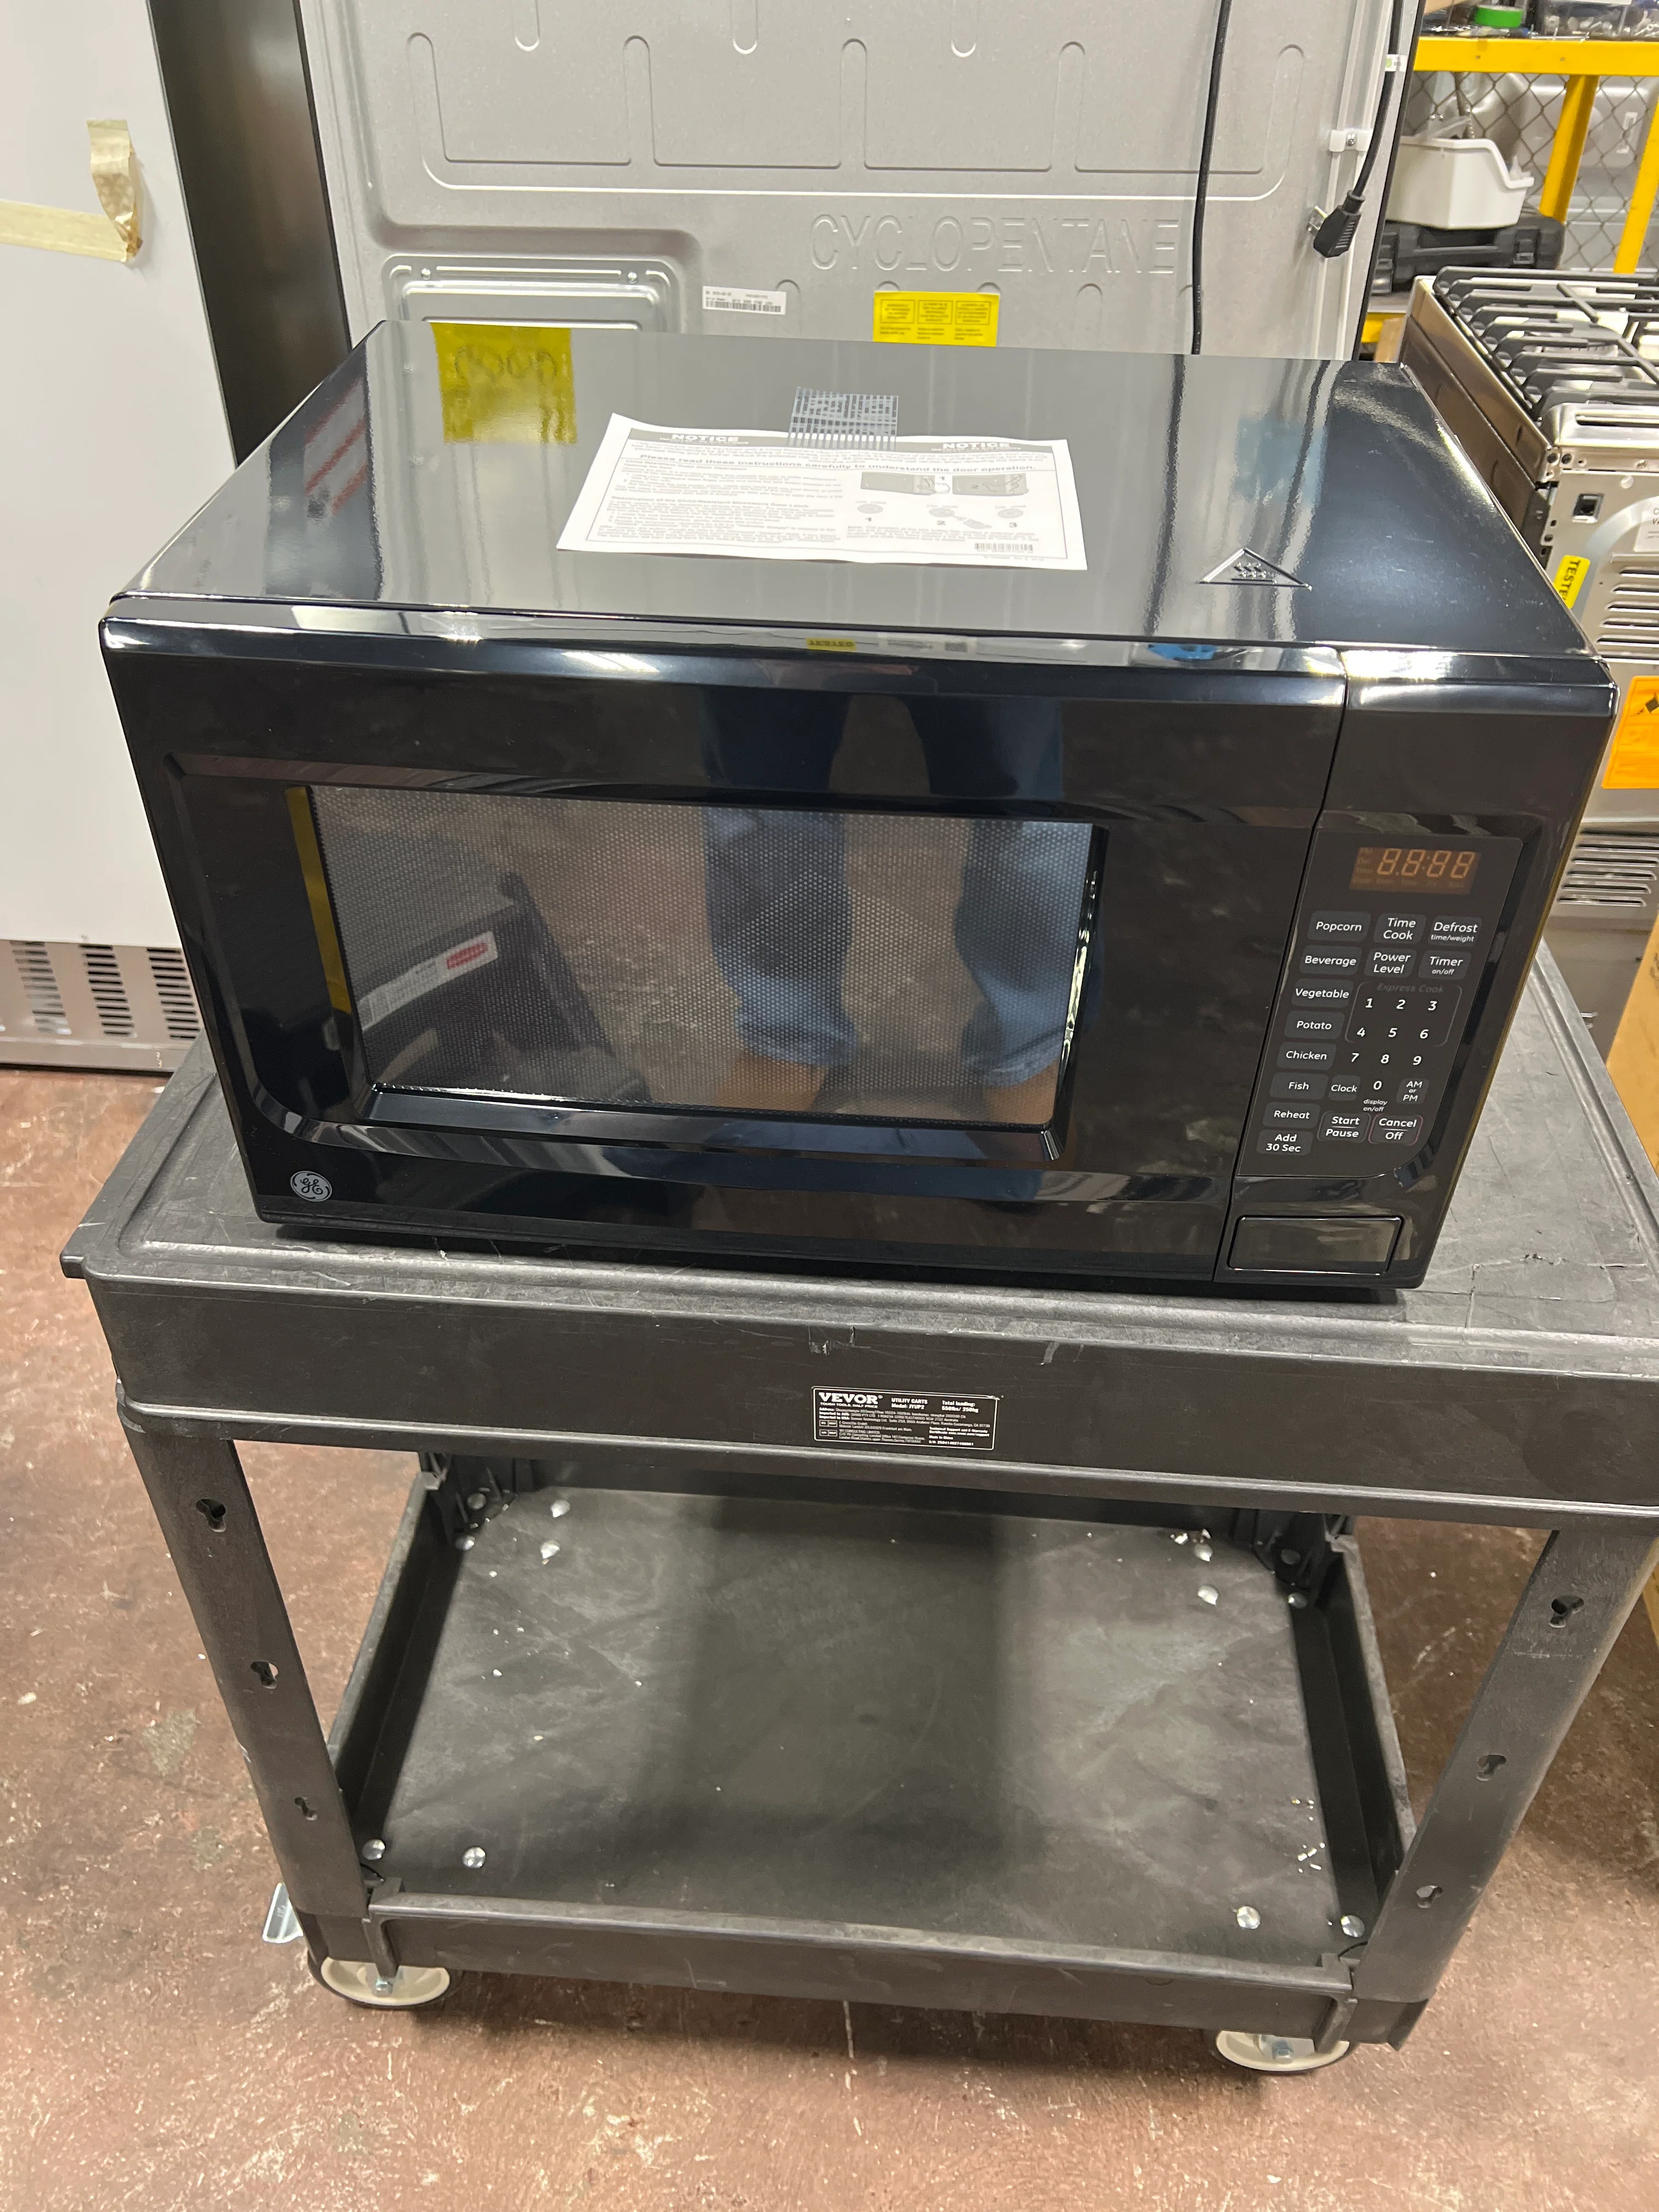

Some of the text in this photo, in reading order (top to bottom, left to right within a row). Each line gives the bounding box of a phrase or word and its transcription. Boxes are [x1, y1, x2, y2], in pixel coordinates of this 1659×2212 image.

[810, 215, 1178, 274] CYCLOPENTANE
[672, 433, 739, 442] NOTICE
[1558, 559, 1582, 601] TESTE
[1316, 921, 1363, 933] Popcorn
[1387, 917, 1417, 928] Time
[1433, 922, 1479, 934] Defrost
[1383, 929, 1414, 940] Cook
[1430, 934, 1475, 943] time/weight
[1304, 955, 1357, 968] Beverage
[1373, 951, 1412, 963] Power
[1429, 956, 1464, 967] Timer
[1373, 963, 1405, 974] Level
[1295, 988, 1350, 1000] Vegetable
[1377, 983, 1444, 994] Express Cook
[1364, 997, 1438, 1012] 1 2 3
[1296, 1020, 1333, 1030] Potato
[1356, 1026, 1430, 1040] 4 5 6
[1285, 1049, 1328, 1060] Chicken
[1351, 1052, 1423, 1066] 7 8 9
[1288, 1081, 1310, 1091] Fish
[1330, 1084, 1358, 1093] Clock
[1373, 1080, 1383, 1091] 0
[1406, 1080, 1423, 1089] AM
[1402, 1094, 1419, 1102] PM
[1273, 1109, 1311, 1120] Reheat
[1331, 1115, 1361, 1126] Start
[1378, 1118, 1418, 1128] Cancel
[1274, 1133, 1298, 1143] Add
[1325, 1128, 1359, 1138] Pause
[1384, 1131, 1405, 1141] Off
[1265, 1143, 1302, 1153] 30 Sec
[819, 1392, 878, 1404] VEVOR
